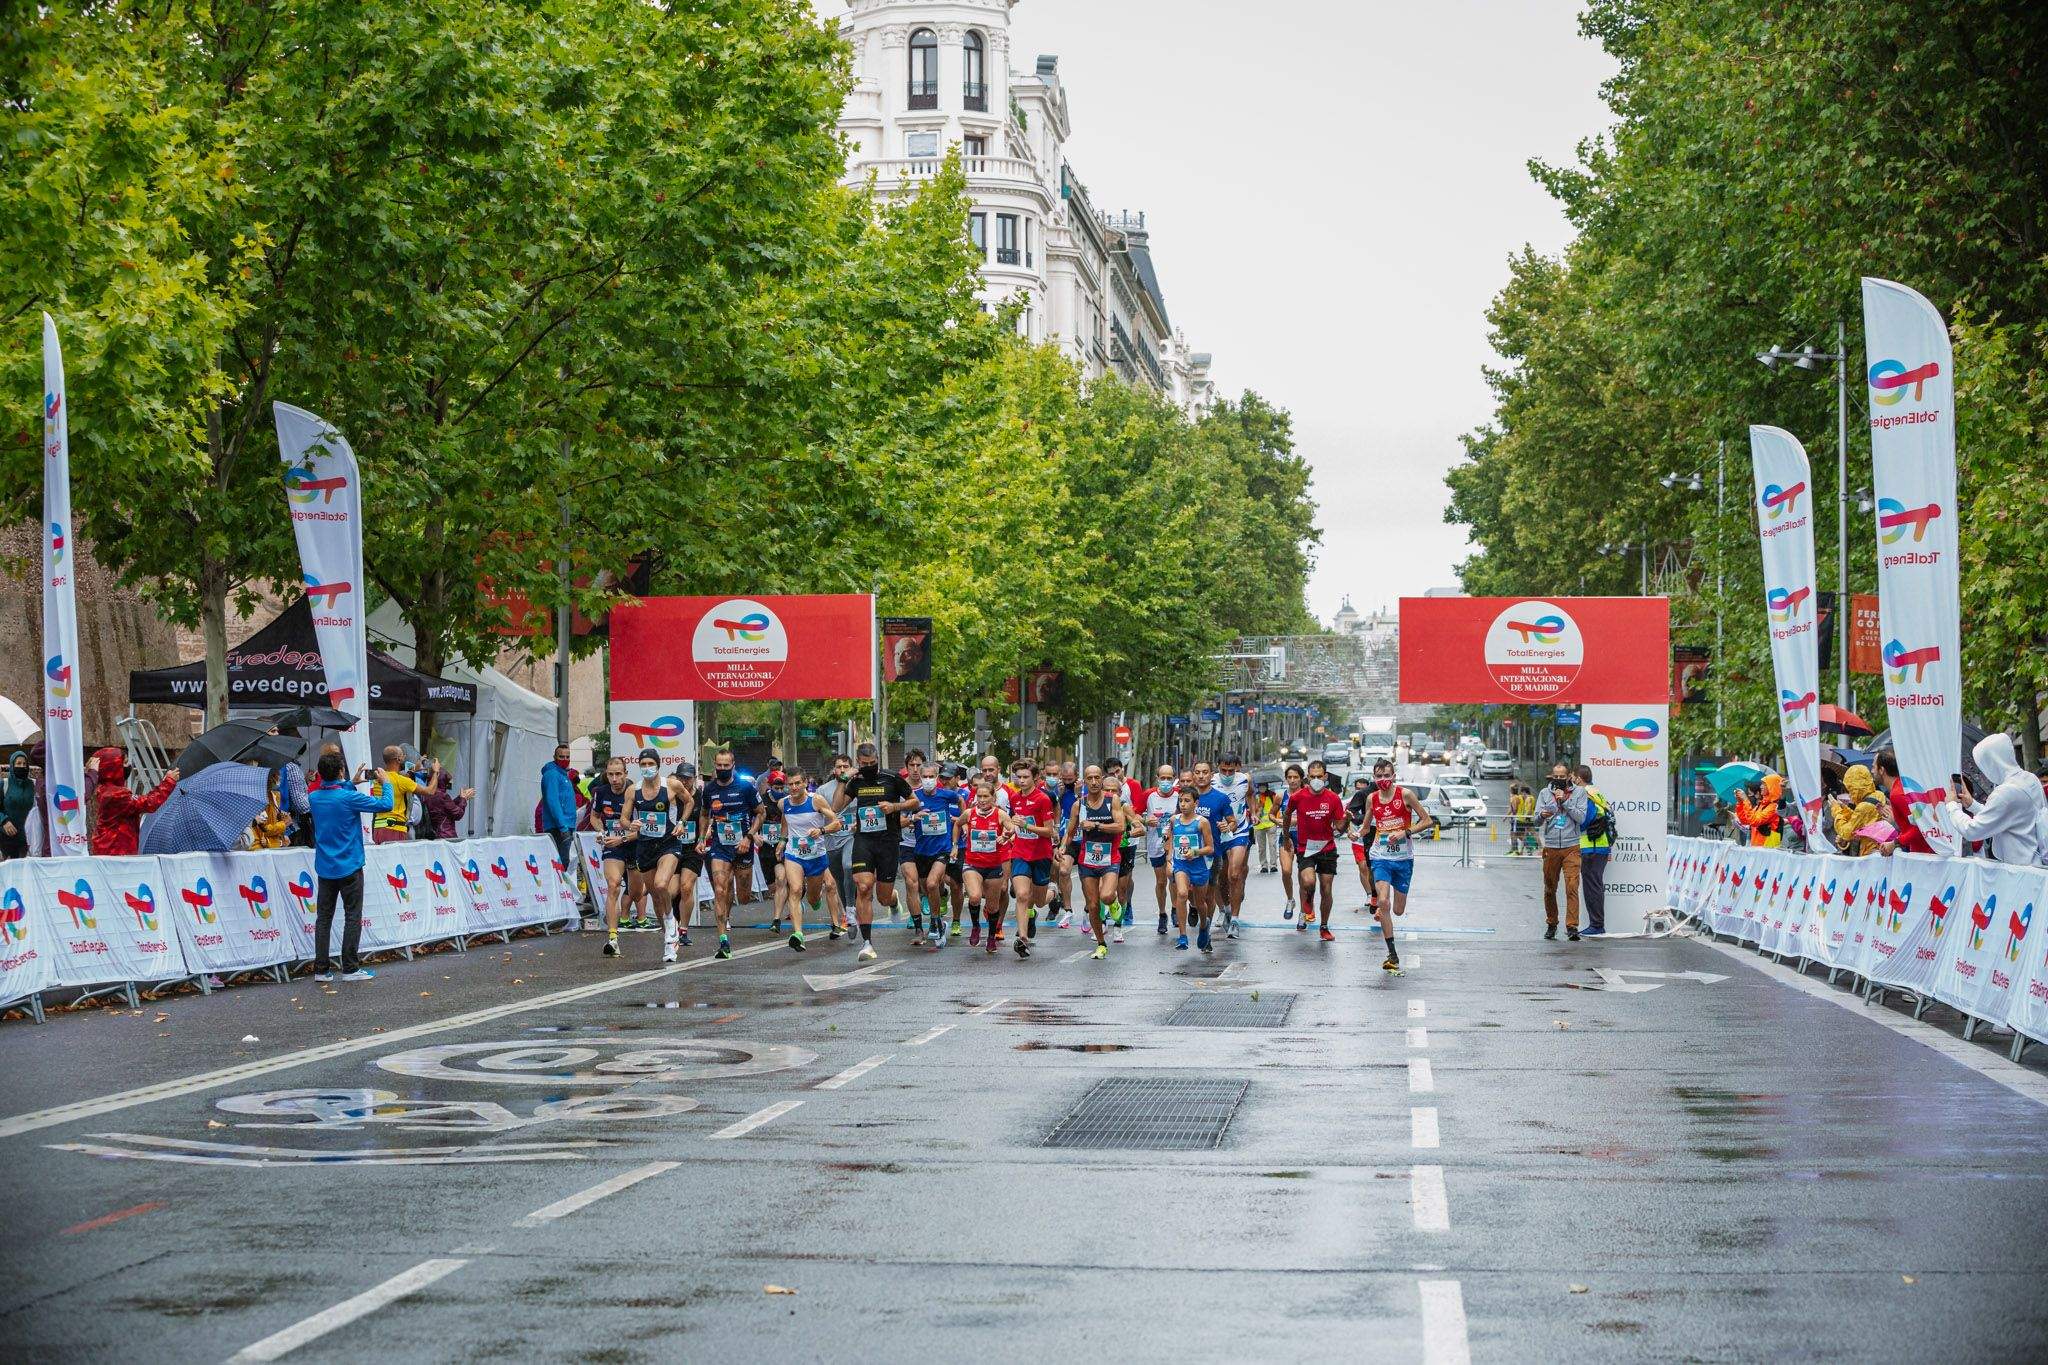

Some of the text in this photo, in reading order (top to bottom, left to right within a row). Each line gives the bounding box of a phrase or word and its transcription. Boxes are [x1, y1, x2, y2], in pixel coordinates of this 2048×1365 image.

[713, 646, 770, 656] TotalEnergies
[1507, 649, 1565, 659] TotalEnergies
[727, 663, 754, 671] MILLA
[1521, 666, 1549, 674] MILLA
[717, 680, 764, 688] DE MADRID
[1510, 684, 1559, 692] DE MADRID
[1590, 757, 1659, 769] TotalEnergies
[865, 818, 879, 827] 284
[645, 824, 659, 832] 285
[1615, 842, 1653, 852] MILLA
